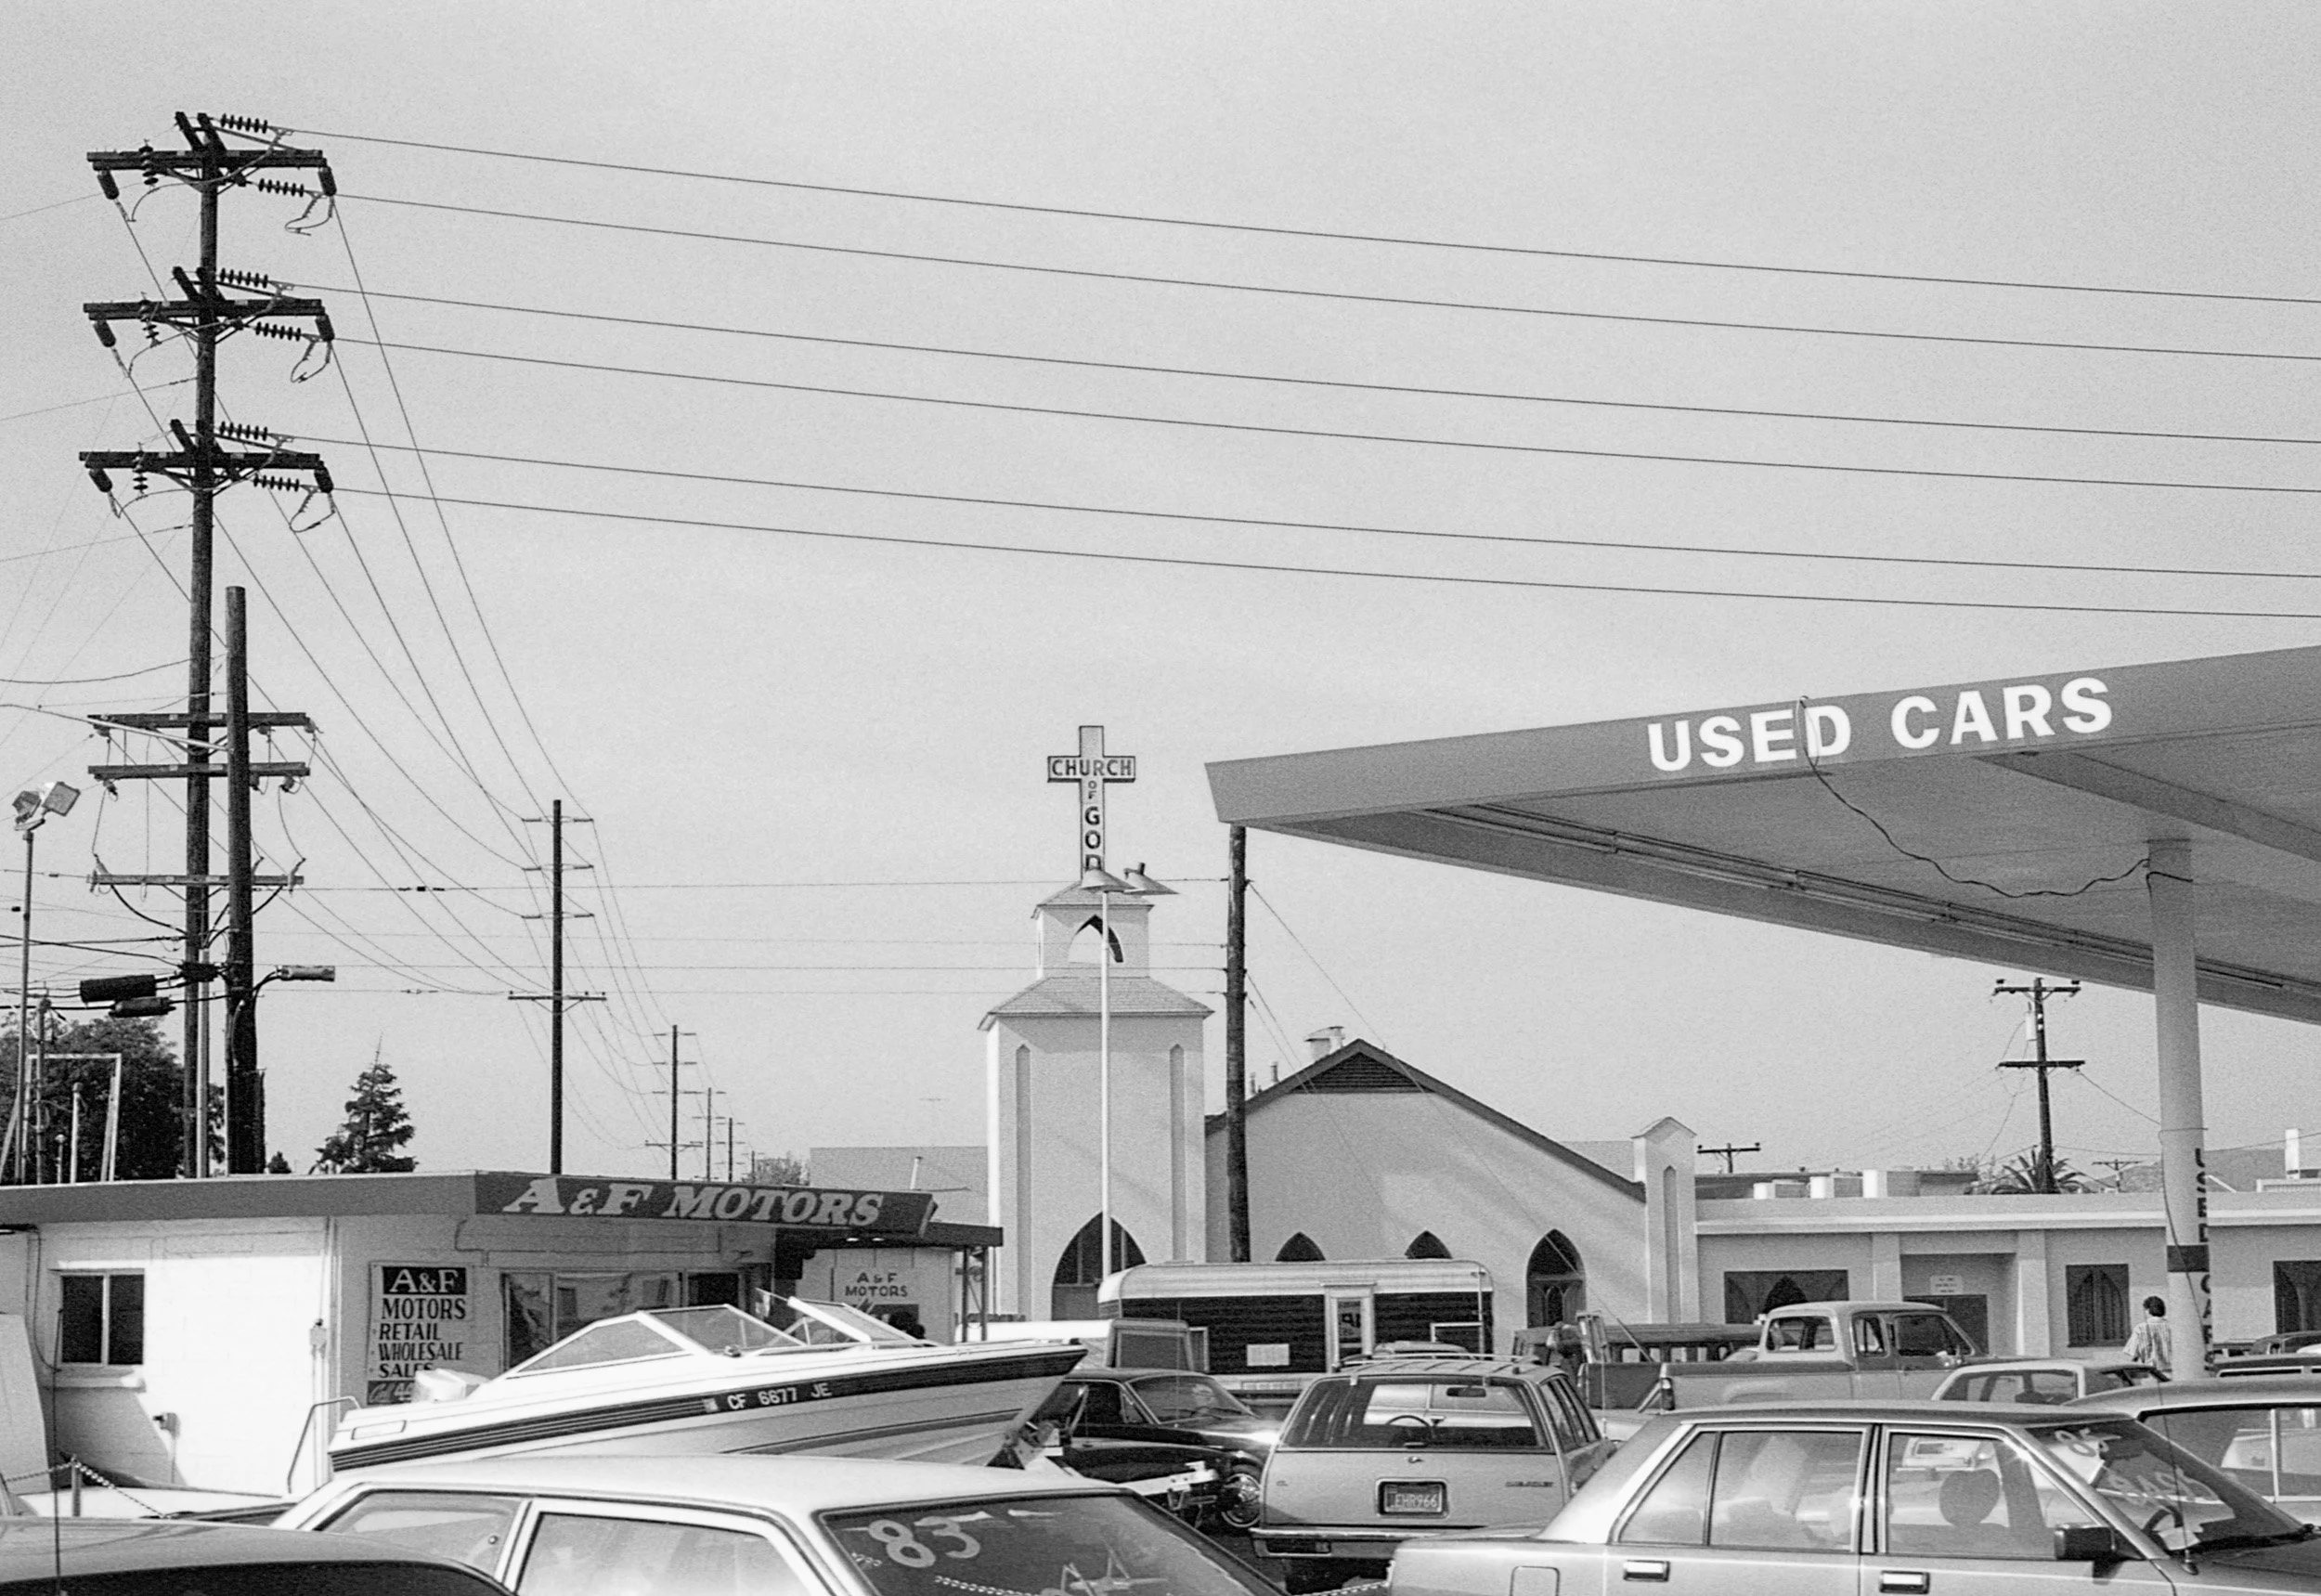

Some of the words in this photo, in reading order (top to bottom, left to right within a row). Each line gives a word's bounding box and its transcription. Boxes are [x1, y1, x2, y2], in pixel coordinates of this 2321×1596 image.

[1647, 705, 1852, 772] USED
[1890, 677, 2113, 750] CARS
[1051, 759, 1132, 776] CHURCH
[1087, 780, 1098, 799] OF
[1084, 806, 1103, 871] GOD
[502, 1176, 654, 1215] A&F
[659, 1185, 885, 1226] MOTORS
[388, 1268, 460, 1293] A&F
[845, 1285, 908, 1297] MOTORS
[381, 1298, 467, 1320] MOTORS
[378, 1322, 442, 1341] RETAIL
[378, 1342, 464, 1361] WHOLESALE
[727, 1394, 746, 1409] CF
[758, 1387, 797, 1405] 6677
[810, 1382, 833, 1398] JE
